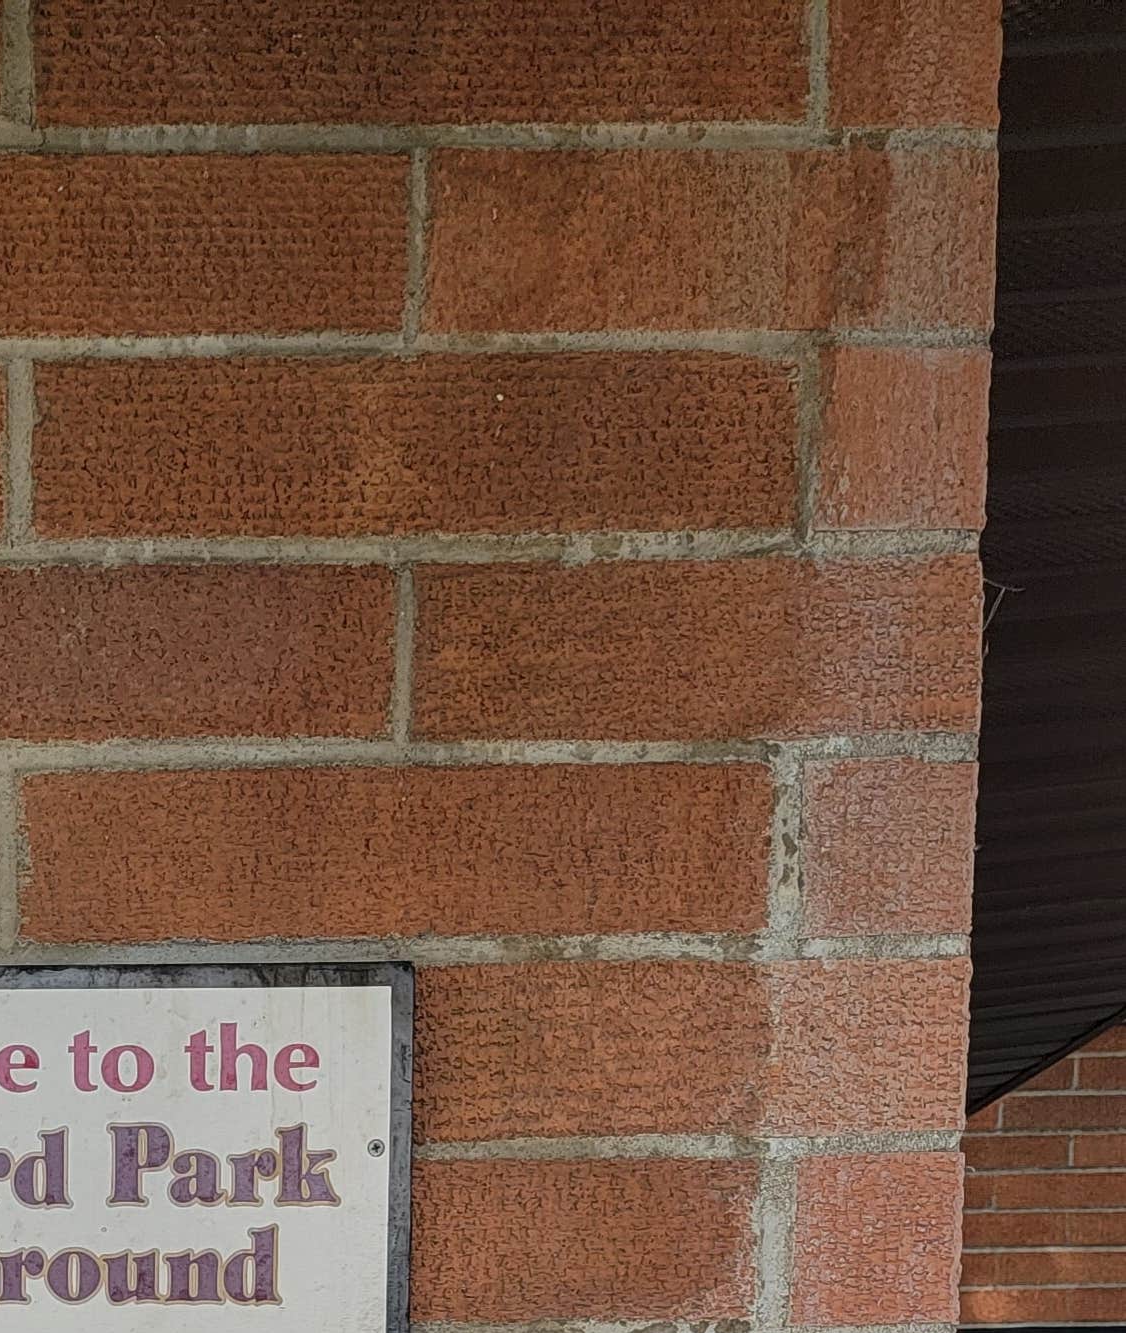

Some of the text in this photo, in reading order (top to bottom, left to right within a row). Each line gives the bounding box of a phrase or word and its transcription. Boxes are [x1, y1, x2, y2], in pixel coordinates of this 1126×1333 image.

[67, 1029, 155, 1093] to
[184, 1022, 320, 1093] the
[105, 1121, 342, 1208] Park
